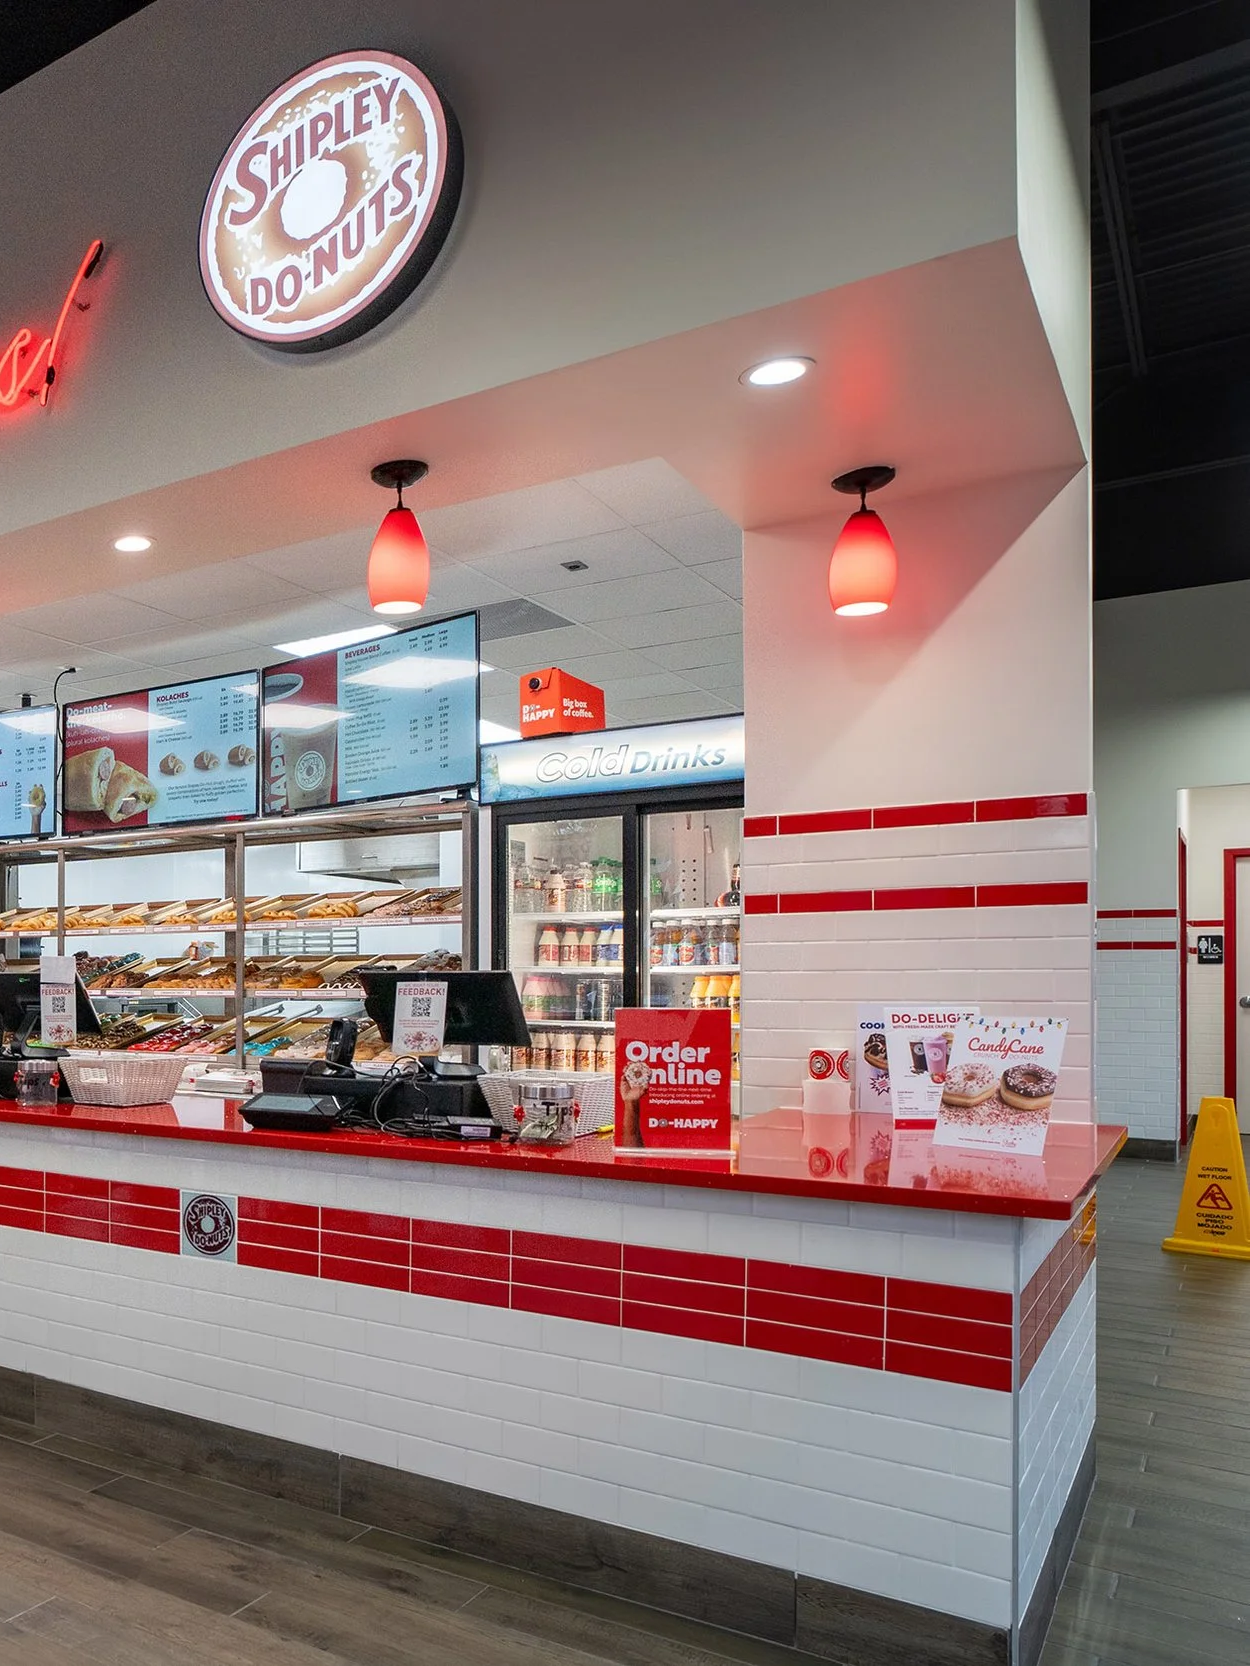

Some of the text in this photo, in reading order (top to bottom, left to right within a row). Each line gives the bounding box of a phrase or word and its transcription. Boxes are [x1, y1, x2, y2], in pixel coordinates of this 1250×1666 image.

[229, 77, 401, 225] SHIPLEY
[250, 159, 412, 315] DO-NUTS
[344, 644, 381, 659] BEVERAGES
[156, 691, 190, 703] KOLACHES
[563, 698, 587, 709] Big box
[522, 708, 556, 723] HAPPY
[571, 709, 594, 718] coffee.
[536, 744, 727, 783] Cold Drinks
[42, 988, 75, 996] FEEDBACK!
[398, 987, 445, 996] FEEDBACK!
[625, 1041, 710, 1063] Order
[542, 1101, 573, 1125] Tips
[648, 1118, 718, 1129] DO-HAPPY
[189, 1203, 225, 1222] SHIPLEY
[1196, 1212, 1234, 1220] CUIDADO
